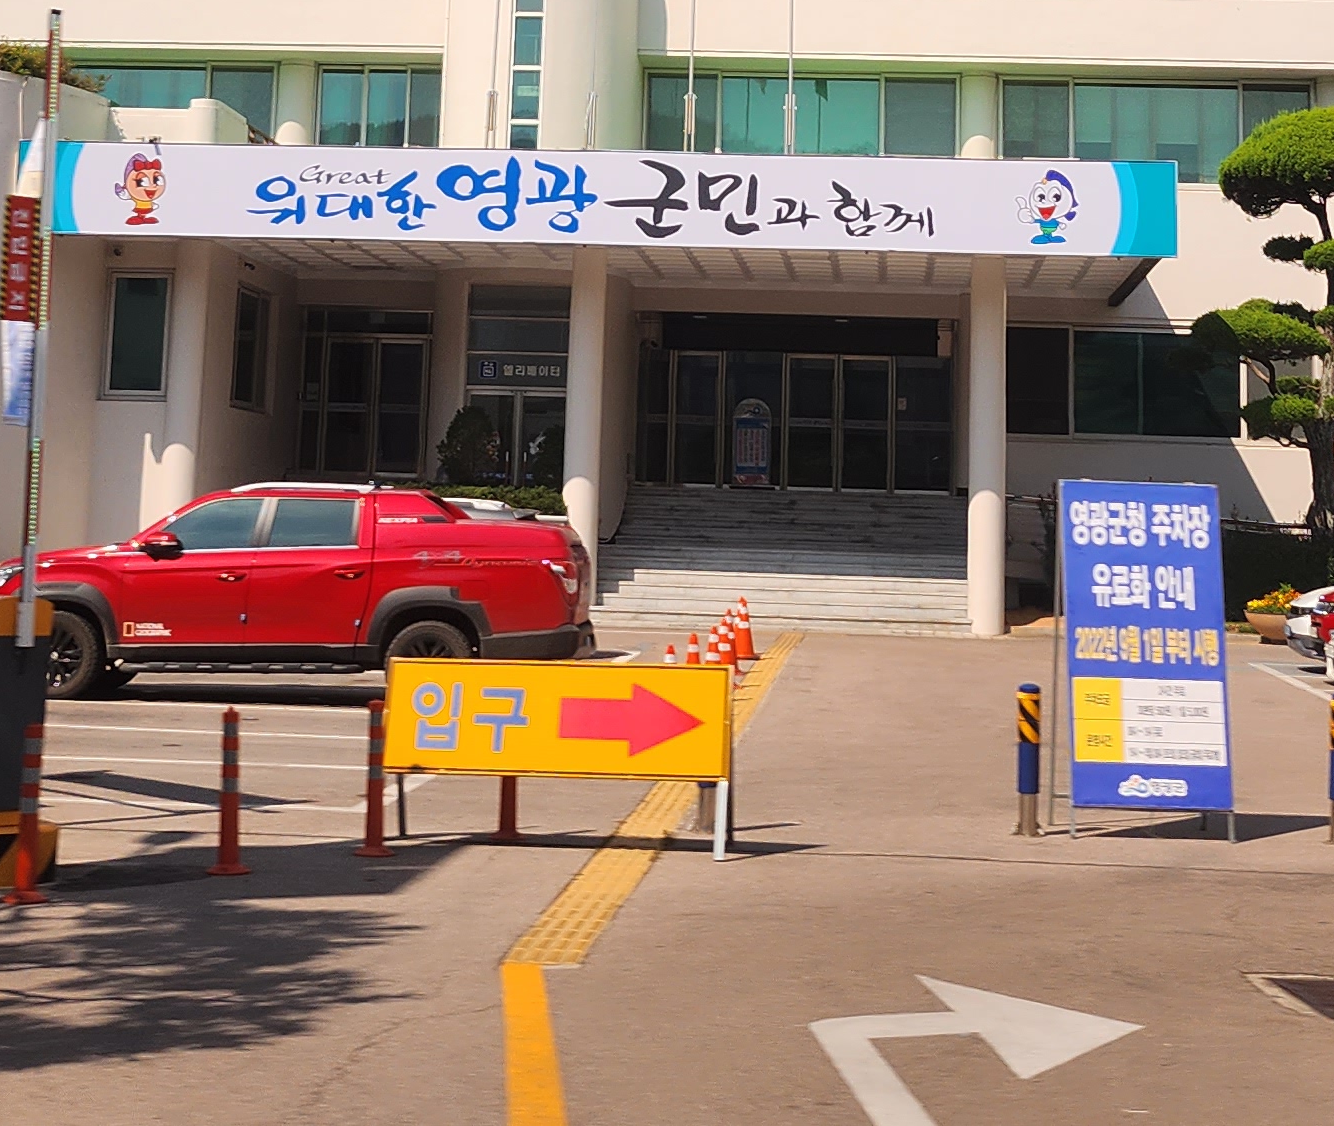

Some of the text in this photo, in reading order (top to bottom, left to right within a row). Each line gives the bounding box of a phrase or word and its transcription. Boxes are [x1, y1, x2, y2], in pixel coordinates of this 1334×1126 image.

[247, 171, 436, 232] 위대한
[436, 155, 598, 234] 영광
[825, 180, 936, 238] 함께
[299, 164, 392, 185] Great
[503, 364, 560, 377] 엘리베이터
[1069, 500, 1212, 550] 영광군청 주차장
[1091, 563, 1196, 611] 유료화 안내
[1074, 625, 1118, 662] 2022년
[410, 680, 530, 755] 입구
